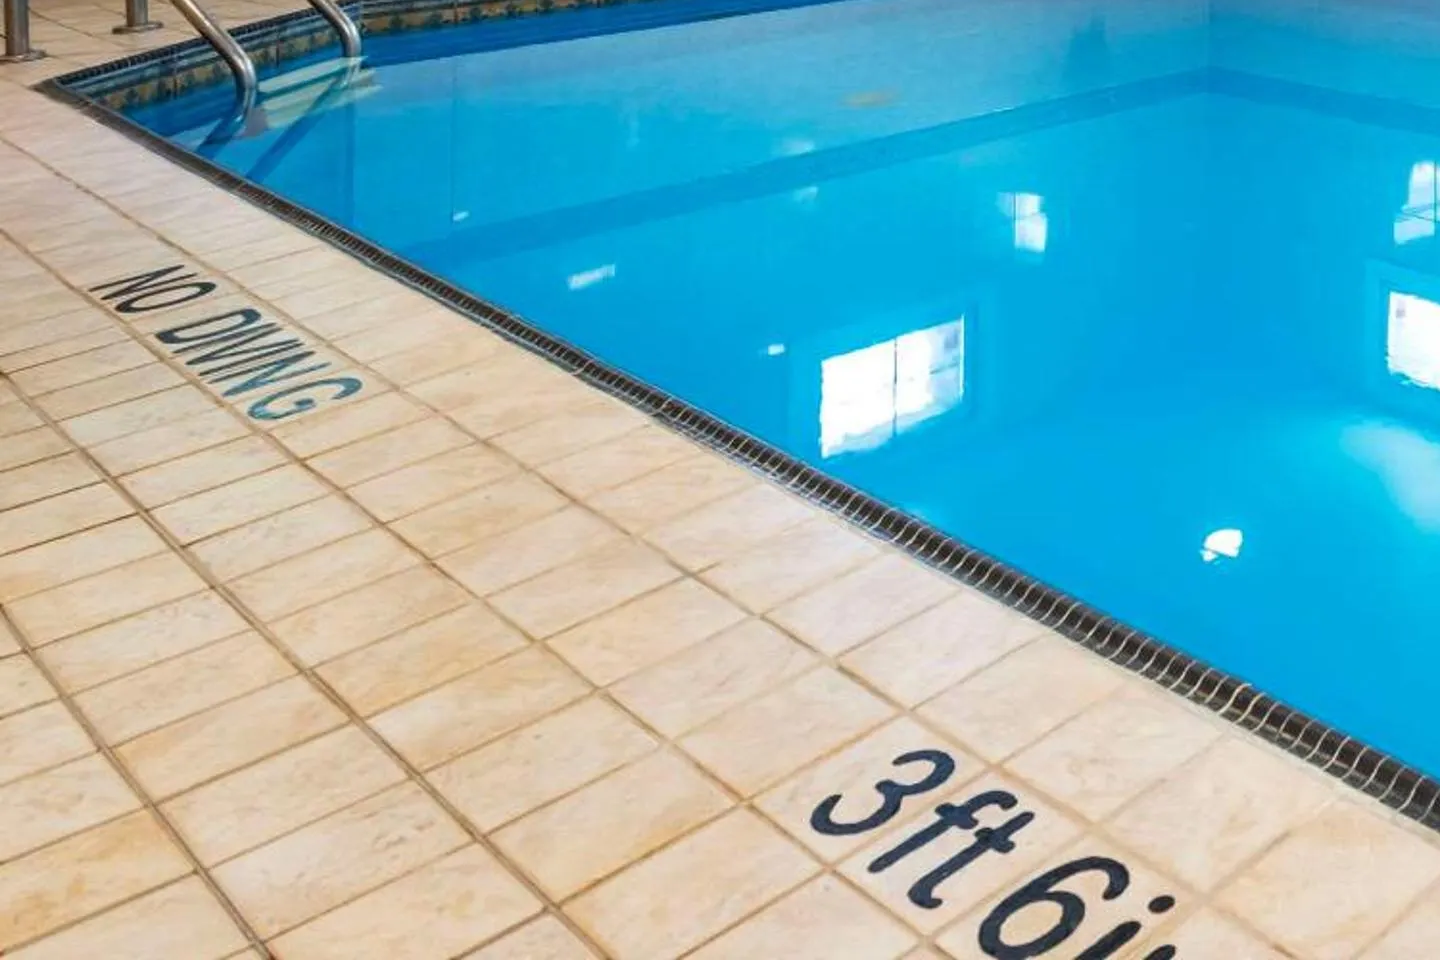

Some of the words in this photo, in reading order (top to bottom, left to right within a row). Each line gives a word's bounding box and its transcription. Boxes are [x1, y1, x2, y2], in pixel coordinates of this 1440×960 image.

[87, 263, 218, 314] NO
[154, 308, 364, 421] DIVING
[809, 748, 1036, 910] 3ft
[977, 855, 1177, 960] 6i
